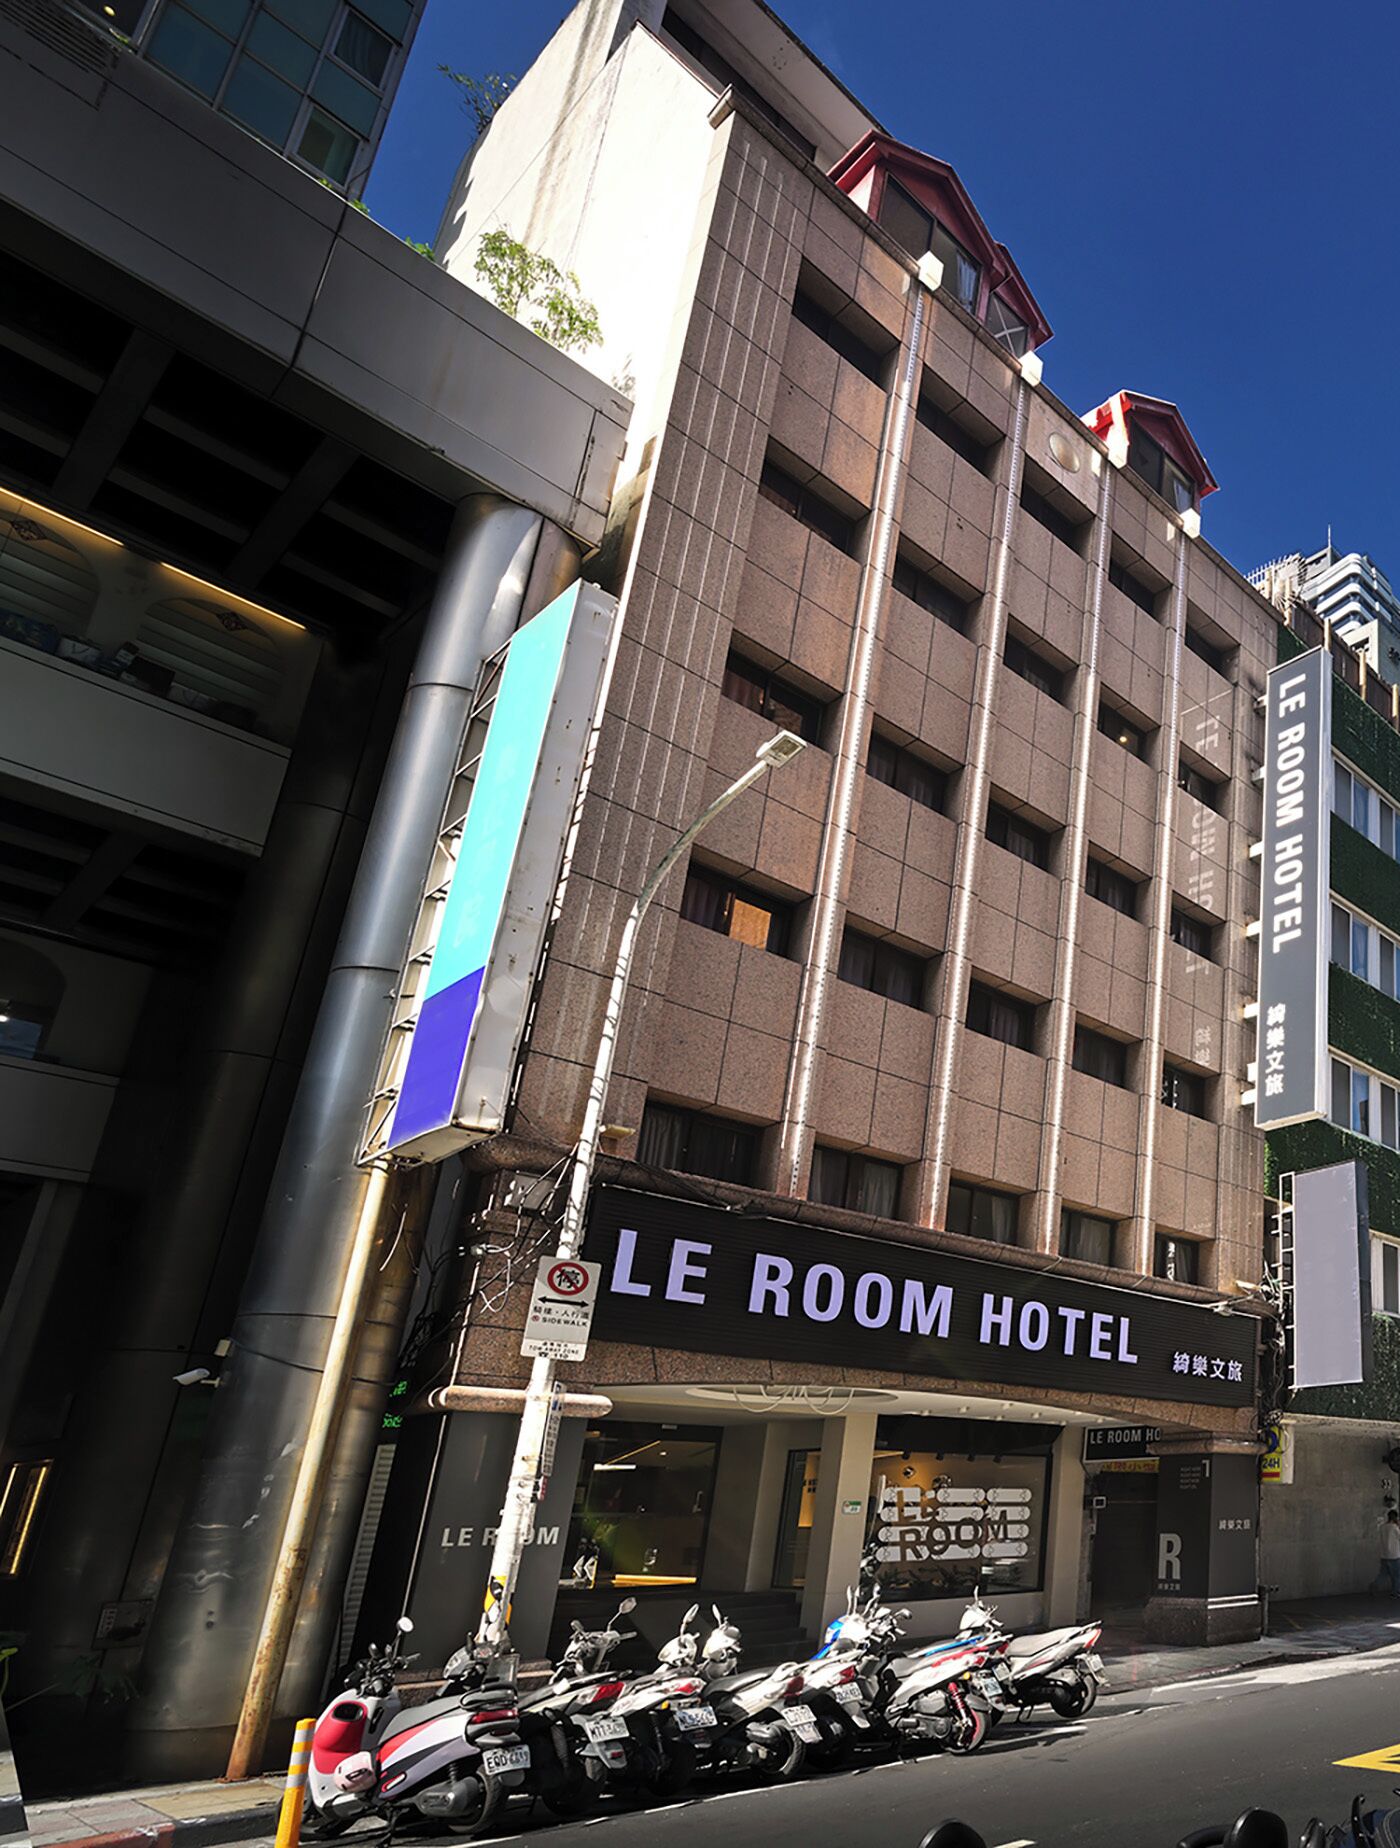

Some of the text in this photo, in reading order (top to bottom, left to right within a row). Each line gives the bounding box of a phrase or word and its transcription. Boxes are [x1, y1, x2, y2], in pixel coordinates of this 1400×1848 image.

[1273, 673, 1306, 953] LE ROOM HOTEL
[1265, 1003, 1286, 1096] 綺樂文旅
[610, 1228, 1138, 1364] LE ROOM HOTEL
[541, 1316, 588, 1328] SIDEWALK
[1172, 1351, 1243, 1382] 綺樂文旅
[1090, 1431, 1104, 1444] LE
[1107, 1429, 1142, 1444] ROOM
[1262, 1457, 1280, 1469] 24H
[441, 1526, 560, 1547] LE RM
[899, 1508, 1009, 1561] ROOM
[1158, 1533, 1182, 1580] R
